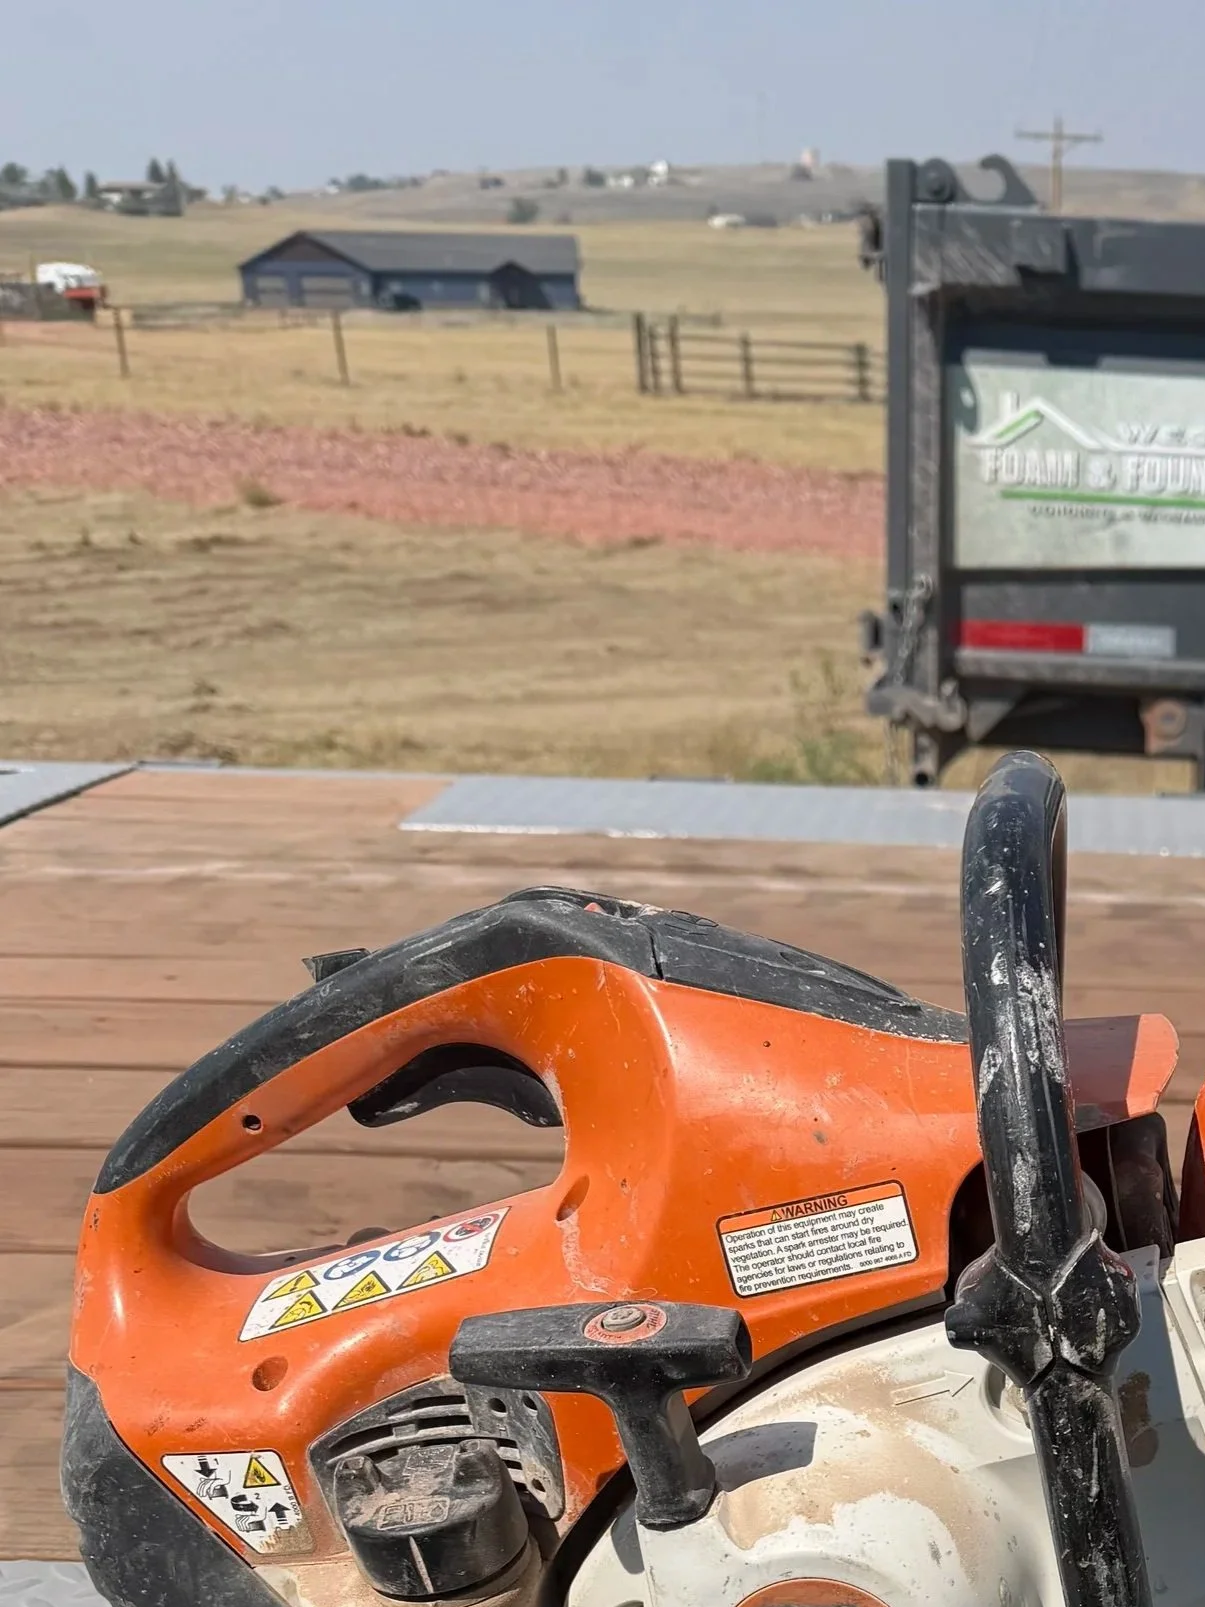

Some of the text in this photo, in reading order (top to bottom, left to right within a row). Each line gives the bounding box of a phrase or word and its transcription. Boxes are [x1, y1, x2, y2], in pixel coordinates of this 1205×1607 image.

[983, 448, 1080, 488] FOAM
[725, 1203, 884, 1244] Operation of this equipment may create
[783, 1194, 849, 1219] WARNING
[728, 1216, 874, 1254] sparks that can start fires around dry
[731, 1219, 909, 1264] vegetation. A spark arrester may be required.
[733, 1236, 882, 1273] The operator should contact local fire
[737, 1241, 905, 1284] agencies for laws or regulations relating to
[738, 1263, 853, 1293] fire prevention requirements.
[646, 1308, 661, 1330] STIHL
